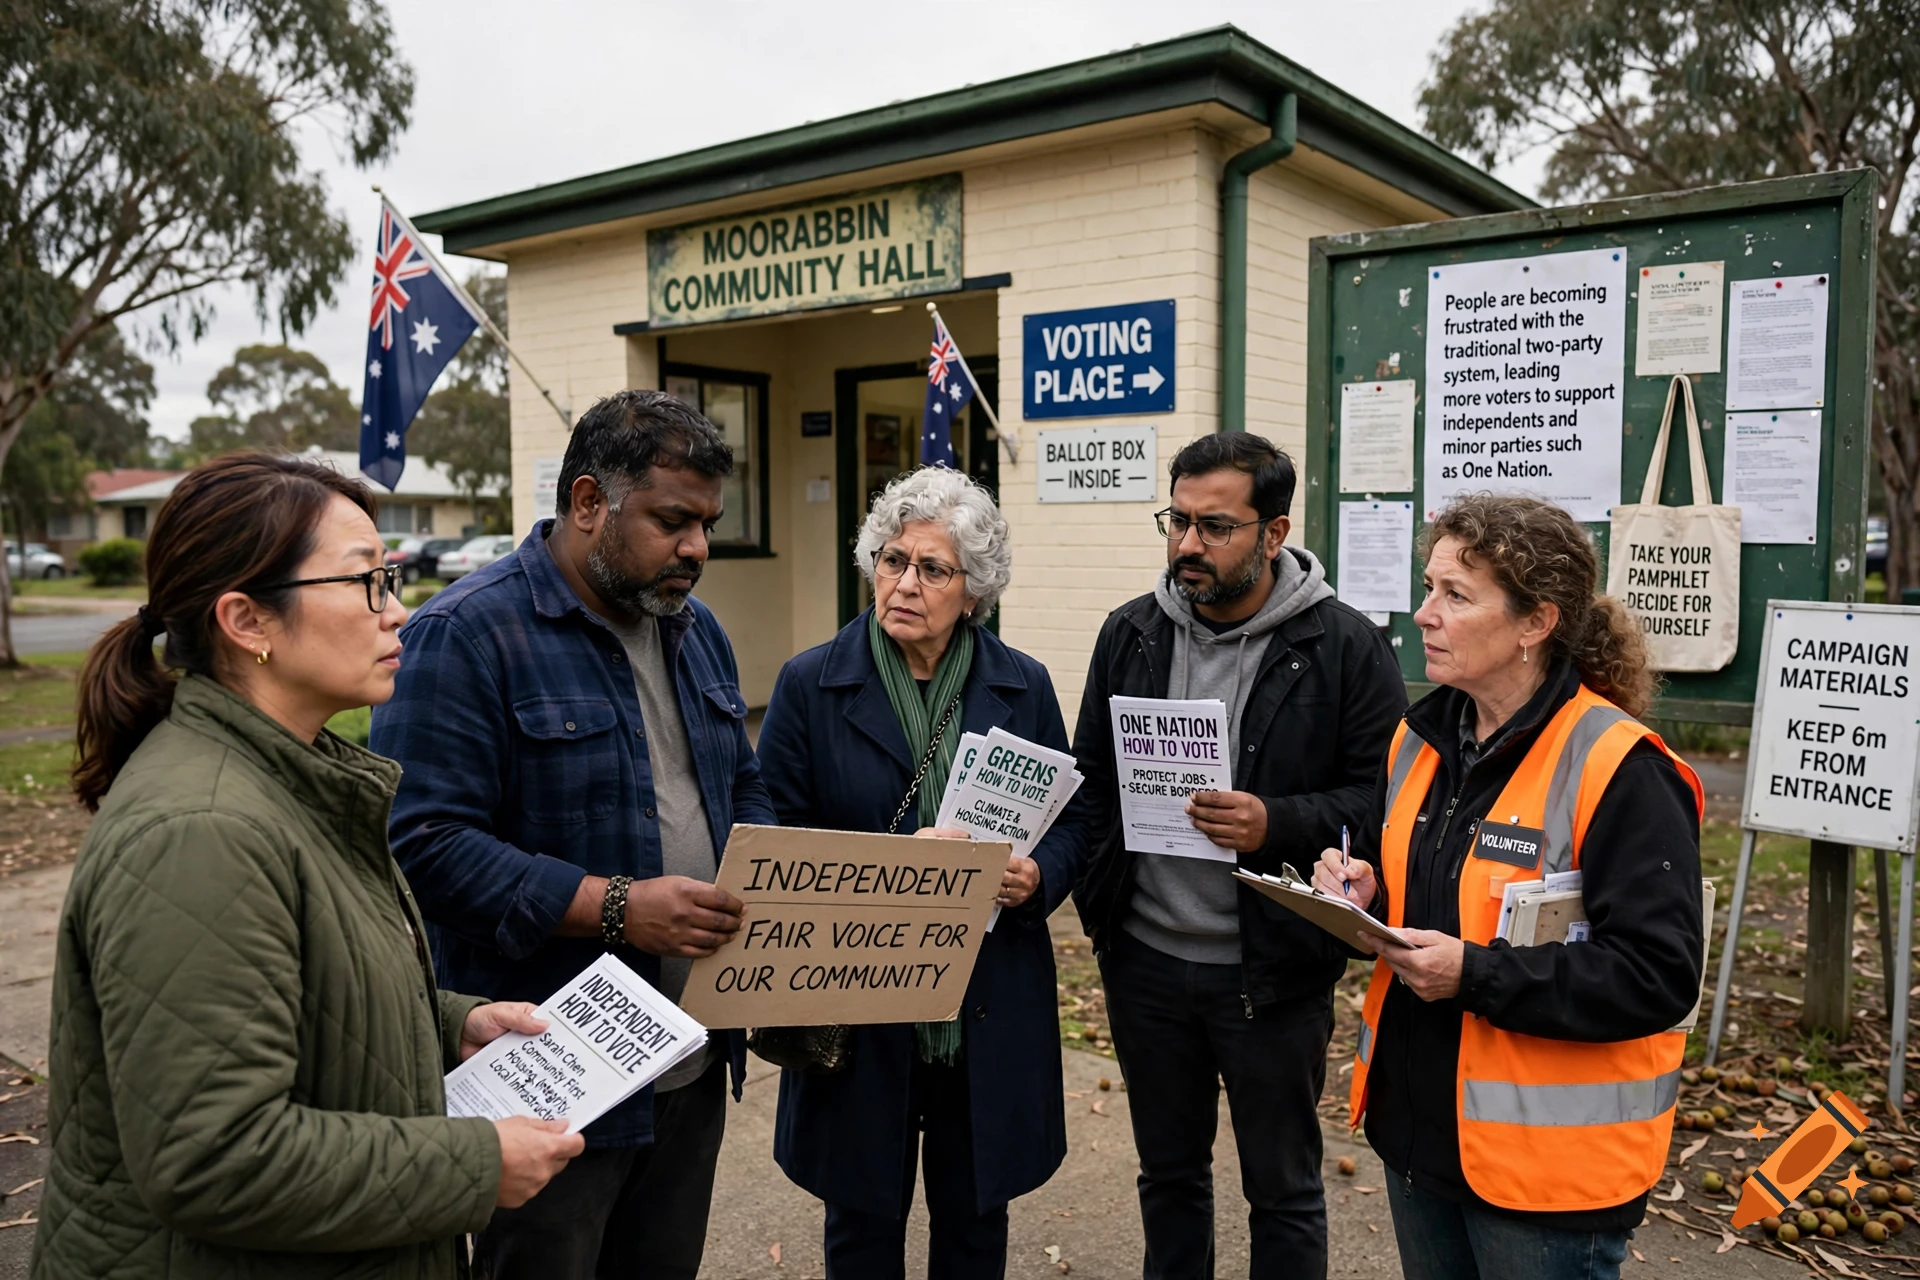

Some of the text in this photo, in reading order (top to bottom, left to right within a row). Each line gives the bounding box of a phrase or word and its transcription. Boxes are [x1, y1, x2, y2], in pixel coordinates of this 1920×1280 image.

[702, 198, 890, 266] MOORABBIN
[663, 239, 946, 314] COMMUNITY HALL
[1445, 283, 1607, 313] People are becoming
[1444, 309, 1585, 335] frustrated with the
[1042, 317, 1152, 362] VOTING
[1444, 334, 1603, 359] traditional two-party
[1443, 361, 1560, 387] system, leading
[1443, 383, 1615, 407] more voters to support
[1443, 409, 1578, 434] independents and
[1046, 440, 1146, 463] BALLOT BOX
[1442, 433, 1582, 458] minor parties such
[1068, 469, 1122, 489] INSIDE
[1442, 460, 1553, 478] as One Nation.
[1629, 544, 1711, 565] TAKE YOUR
[1628, 567, 1710, 589] PAMPHLET
[1683, 594, 1712, 613] FOR
[1639, 616, 1711, 637] OURSELF
[1787, 638, 1909, 667] CAMPAIGN
[1780, 667, 1909, 698] MATERIALS
[1119, 713, 1218, 739] ONE NATION
[1787, 718, 1886, 749] KEEP 6m
[1122, 737, 1219, 760] HOW TO VOTE
[987, 746, 1058, 787] GREENS
[1800, 749, 1866, 777] FROM
[975, 767, 1005, 788] HOW
[1005, 777, 1021, 794] TO
[1020, 783, 1050, 804] VOTE
[1128, 782, 1168, 796] SECURE
[1132, 768, 1207, 785] PROTECT JOBS
[1770, 774, 1893, 811] ENTRANCE
[955, 807, 1031, 842] HOUSING ACTION
[974, 799, 1021, 824] CLIMATE &
[1481, 833, 1537, 856] VOLUNTEER
[742, 858, 982, 898] INDEPENDENT
[743, 919, 969, 950] FAIR VOICE FOR
[715, 962, 951, 993] OUR COMMUNITY
[579, 972, 678, 1054] INDEPENDENT
[557, 992, 651, 1075] HOW TO VOTE
[539, 1032, 587, 1077] Sarah Chen
[489, 1058, 517, 1083] Local
[521, 1040, 587, 1101] Community First
